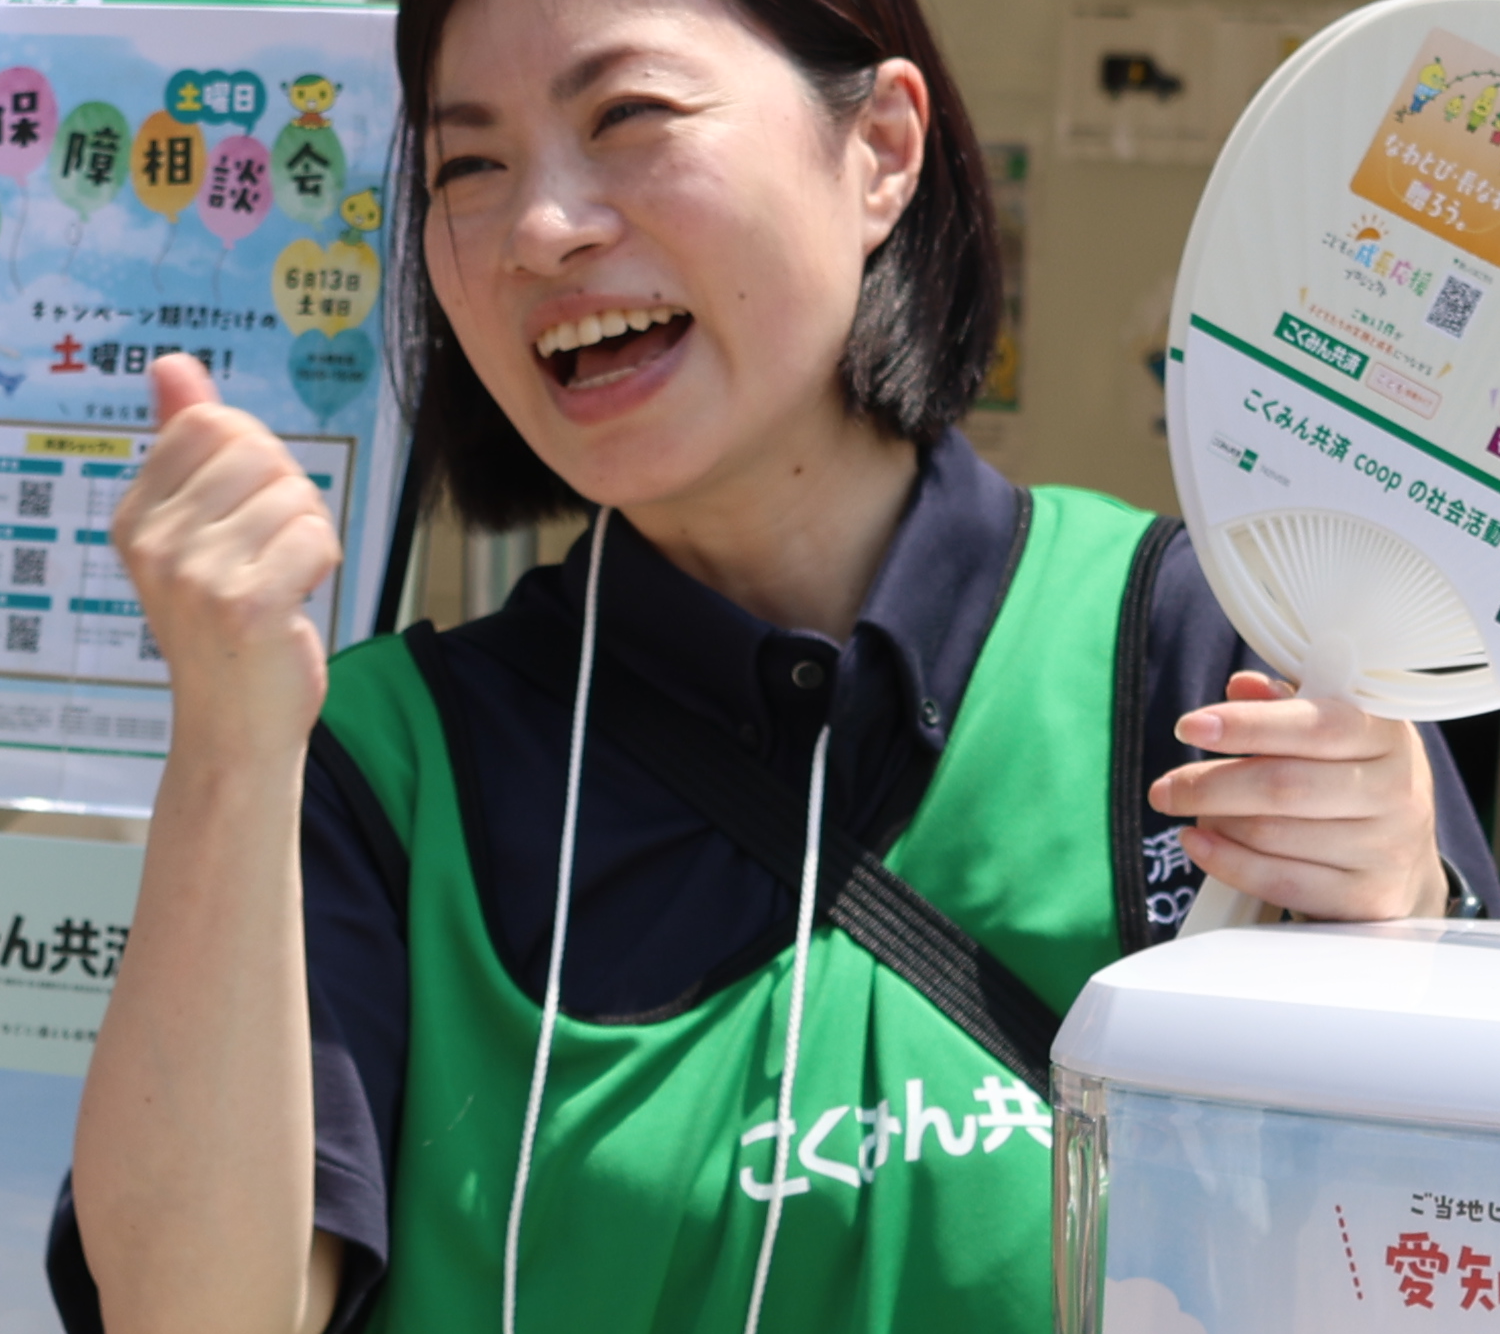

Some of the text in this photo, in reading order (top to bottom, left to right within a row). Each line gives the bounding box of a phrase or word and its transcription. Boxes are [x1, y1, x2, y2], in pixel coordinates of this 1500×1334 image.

[175, 80, 257, 114] 土曜日
[1404, 178, 1466, 232] 贈ろう。
[31, 299, 278, 331] キャンペーン期間だけの
[1281, 319, 1363, 375] こくみん共済
[1243, 388, 1352, 463] こくみん共済
[1354, 453, 1402, 493] coop
